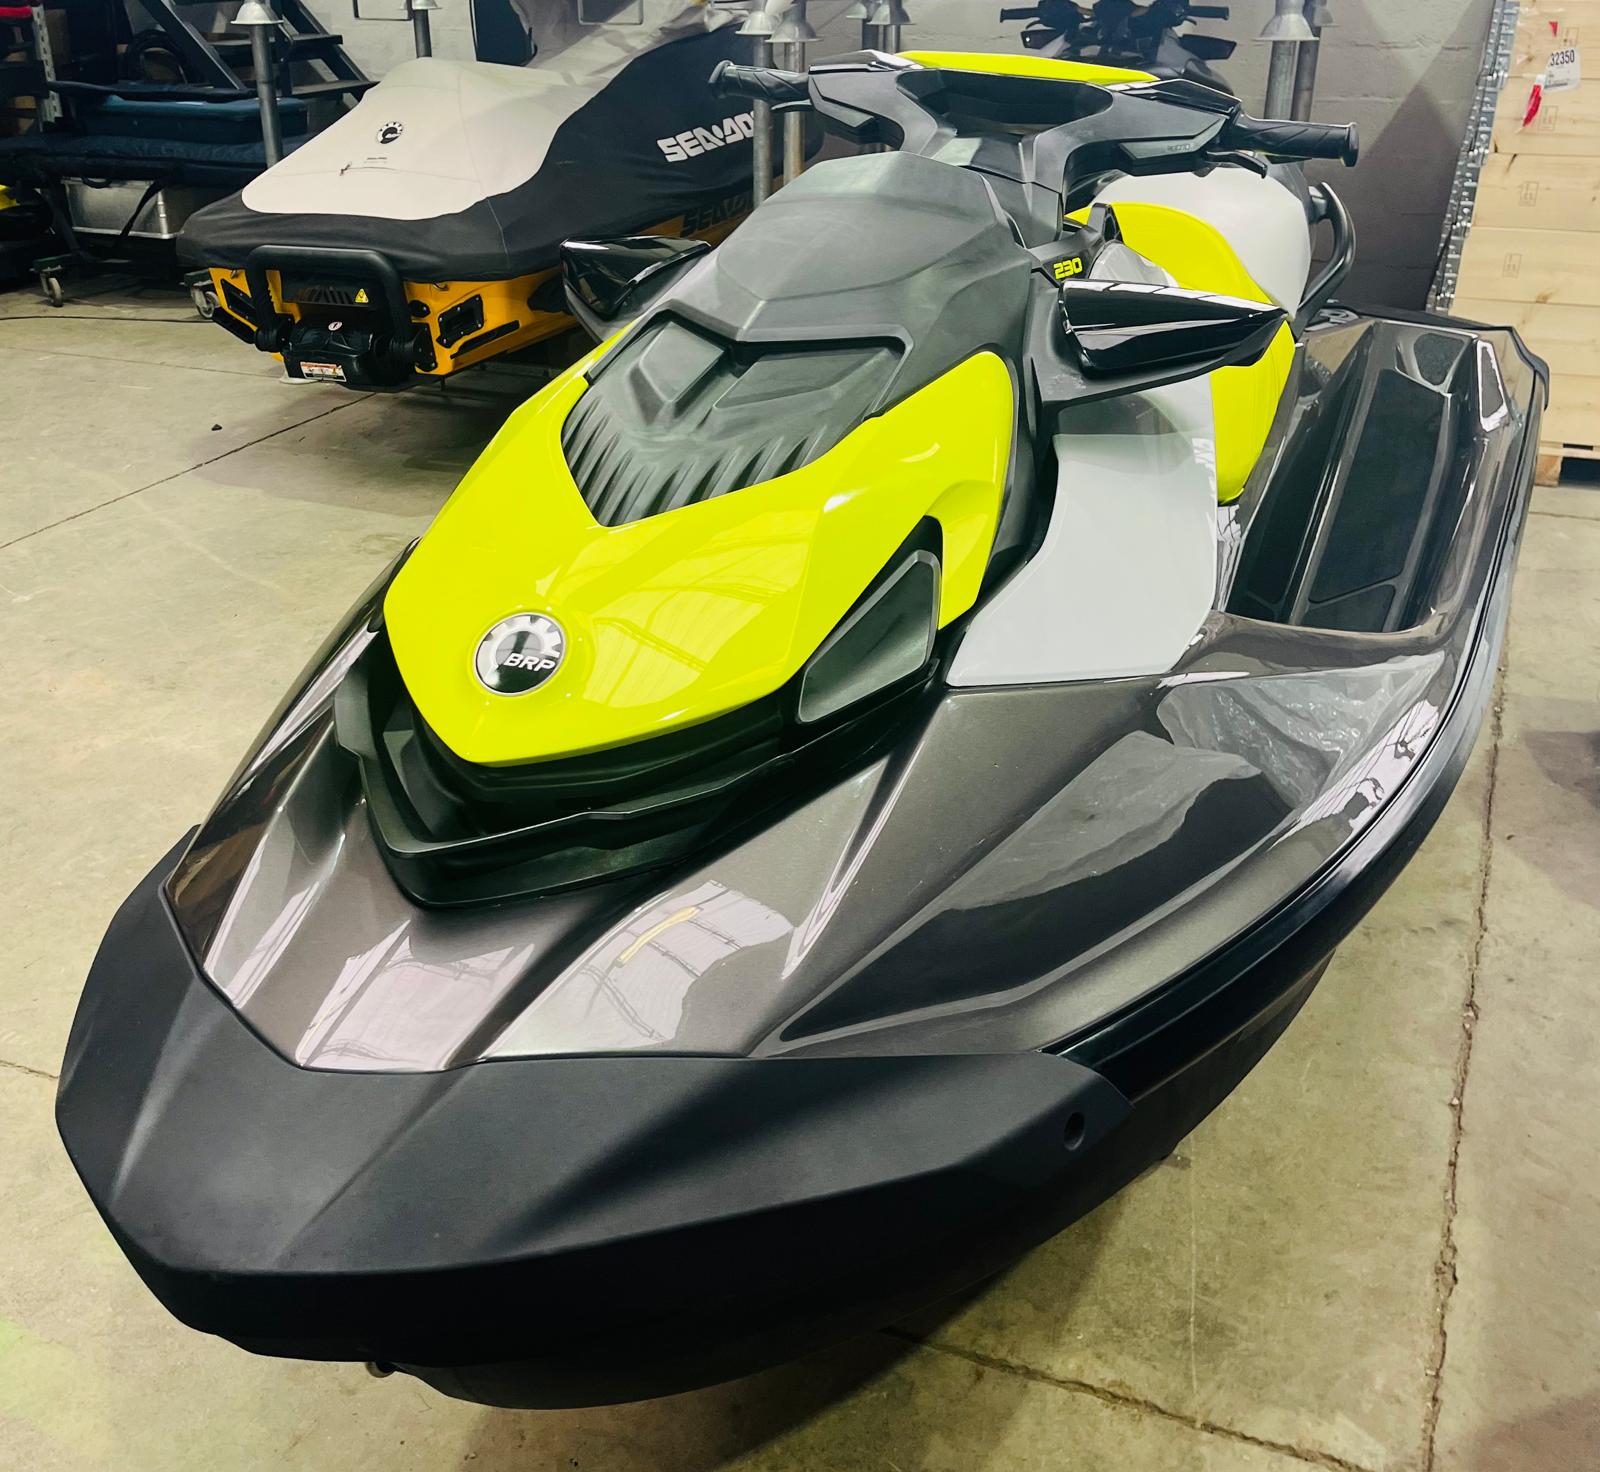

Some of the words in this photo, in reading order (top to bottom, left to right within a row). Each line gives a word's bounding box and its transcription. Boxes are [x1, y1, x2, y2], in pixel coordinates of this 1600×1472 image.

[1550, 49, 1575, 66] 32350
[656, 110, 754, 162] SEA-DO
[1053, 257, 1083, 280] 230
[503, 652, 556, 672] BRP
